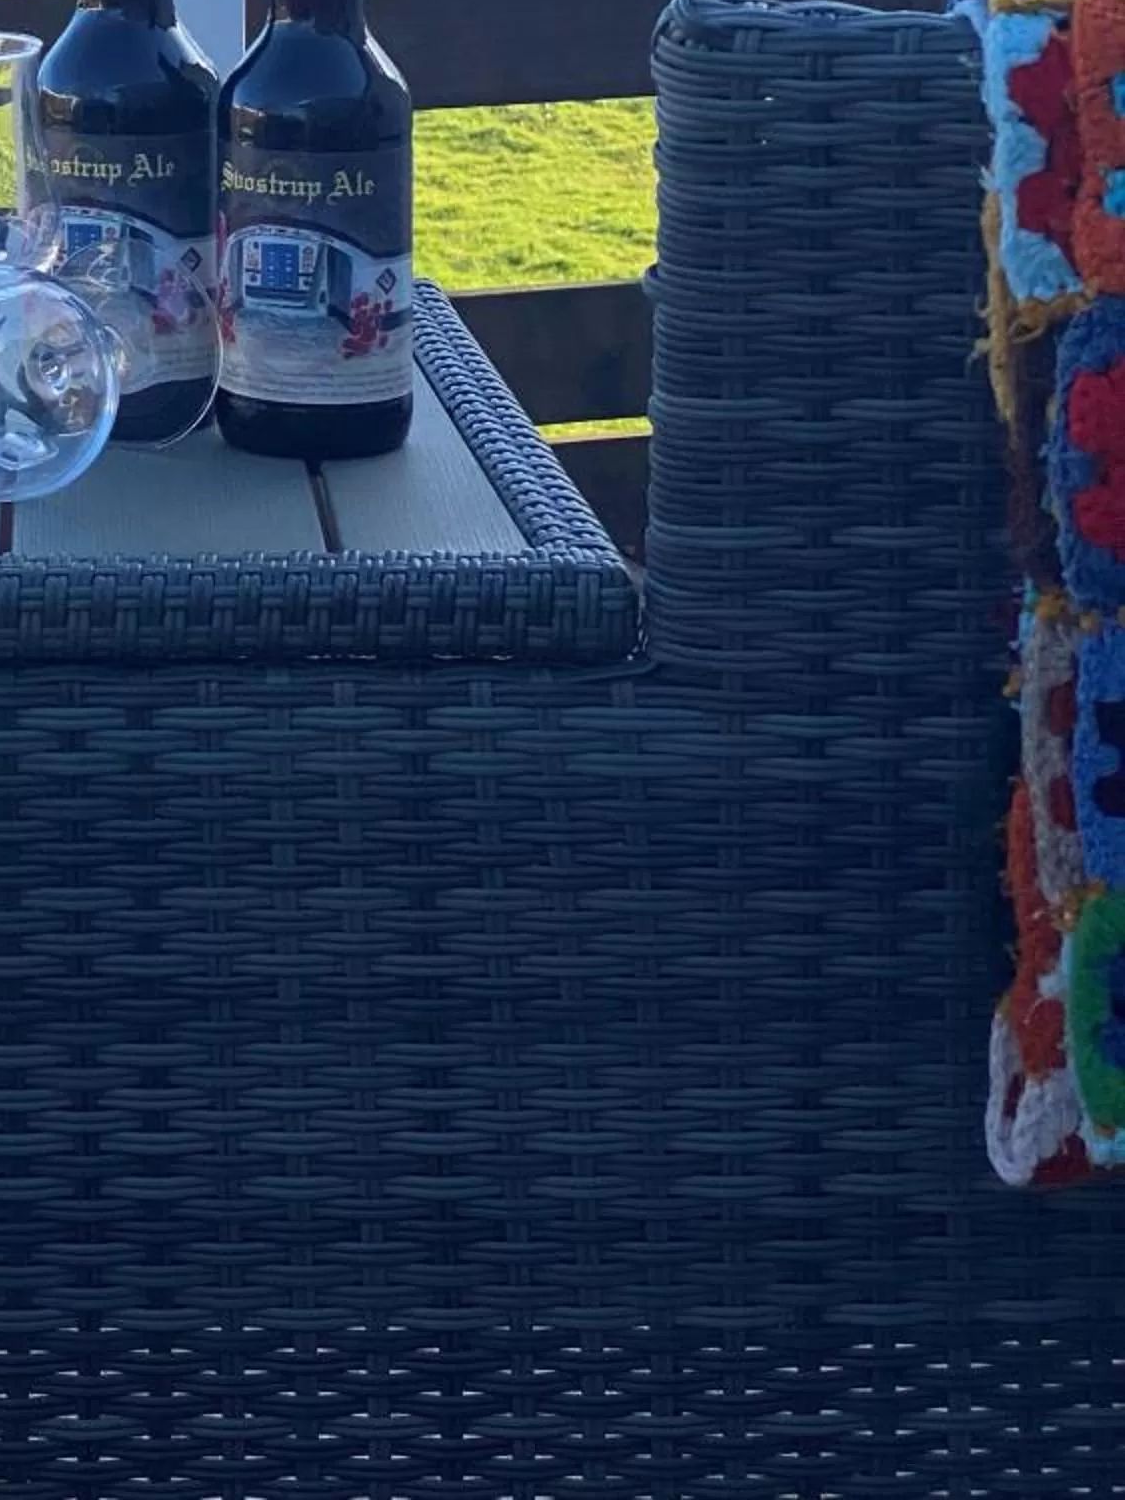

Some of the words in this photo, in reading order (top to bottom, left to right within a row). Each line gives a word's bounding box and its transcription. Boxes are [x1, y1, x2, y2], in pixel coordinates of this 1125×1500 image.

[27, 152, 122, 186] ostrup
[127, 153, 175, 187] Ale
[326, 170, 376, 206] Ale
